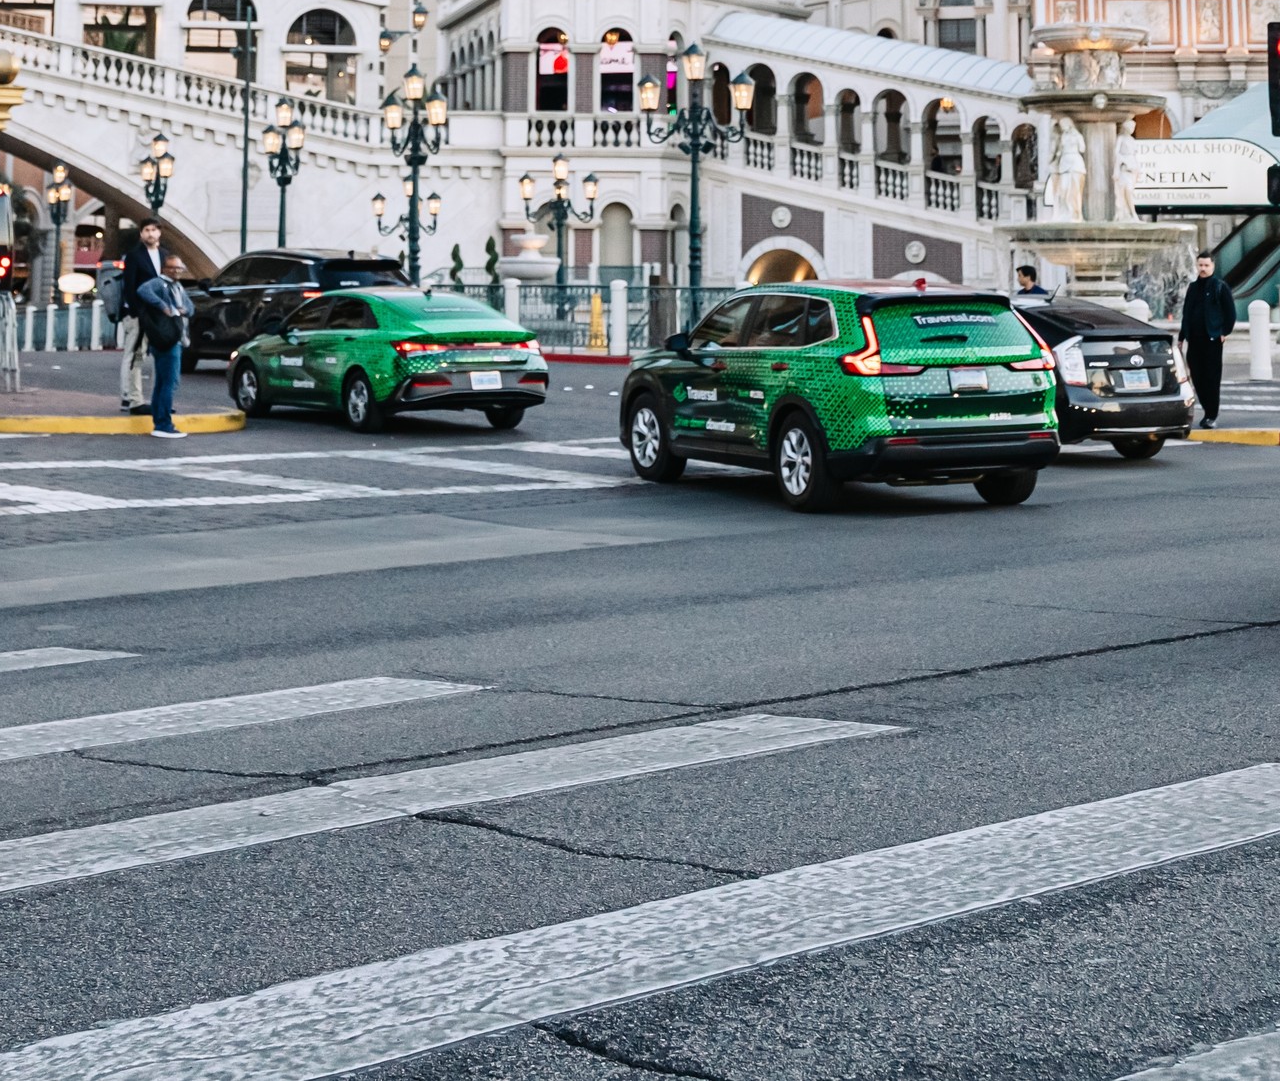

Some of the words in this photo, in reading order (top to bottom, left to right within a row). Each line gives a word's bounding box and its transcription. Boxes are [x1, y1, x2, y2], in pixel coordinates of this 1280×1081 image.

[1153, 144, 1200, 155] CANAL
[1204, 142, 1265, 164] SHOPPES
[1136, 172, 1212, 183] ENETIAN
[913, 313, 996, 326] Traversal.com
[686, 386, 717, 401] Traversal
